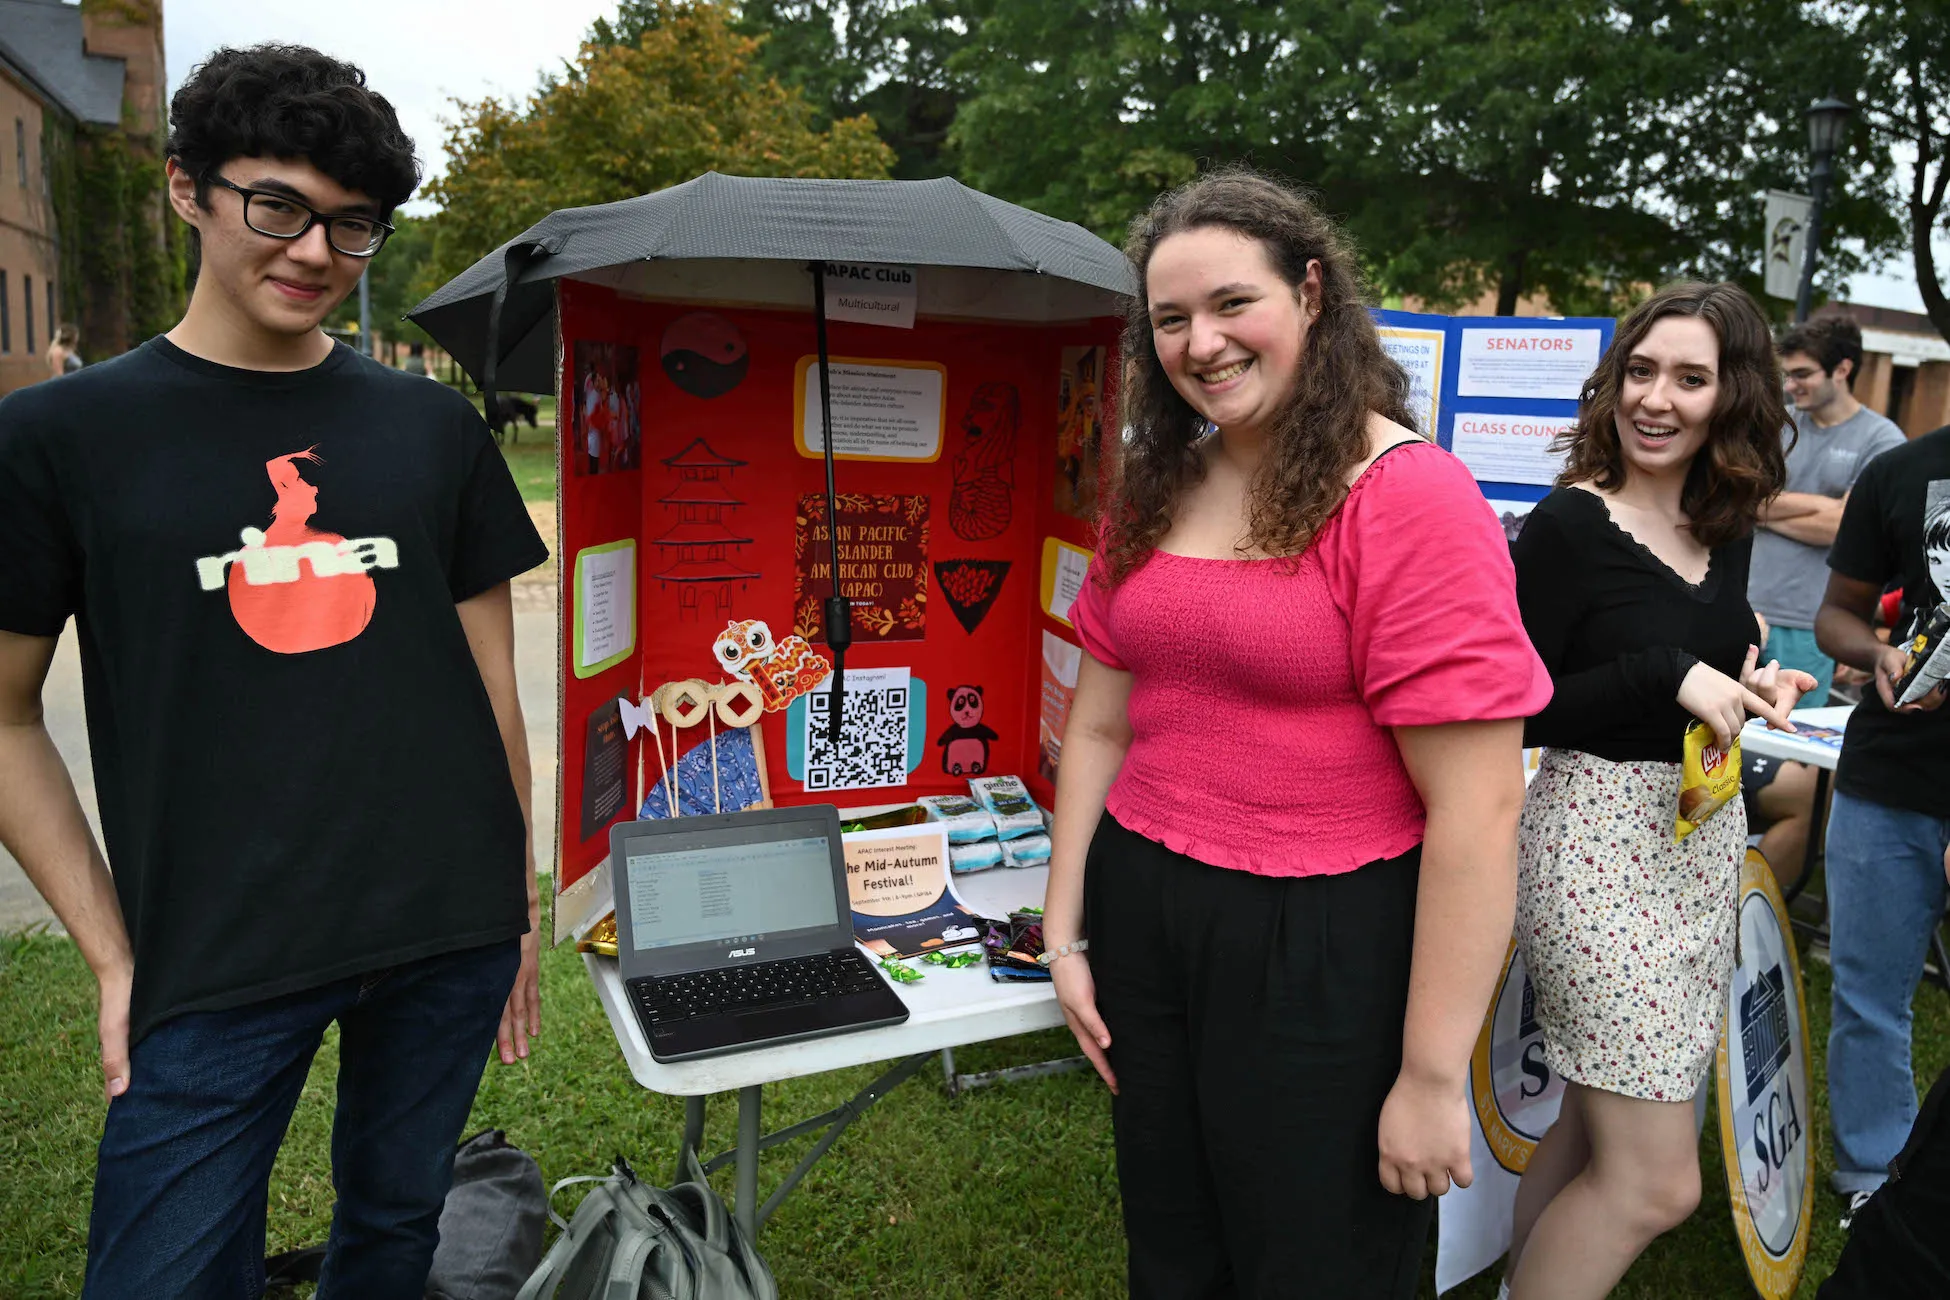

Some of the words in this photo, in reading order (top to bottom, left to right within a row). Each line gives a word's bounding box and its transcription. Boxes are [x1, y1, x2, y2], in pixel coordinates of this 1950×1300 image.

[827, 263, 871, 280] APAC
[876, 269, 912, 284] Club
[838, 298, 900, 312] Multicultural
[1382, 344, 1419, 354] EETINGS
[1487, 337, 1574, 351] SENATORS
[1462, 421, 1507, 435] CLASS
[837, 544, 893, 560] SLANDER
[810, 563, 877, 579] AMRICAN
[883, 563, 914, 579] CLUB
[840, 583, 884, 598] (APAC)
[984, 780, 1018, 791] gimme
[873, 846, 894, 854] Interest
[847, 862, 860, 874] he
[865, 856, 938, 872] Mid-Autumn
[864, 875, 913, 890] Festival!
[728, 947, 756, 959] ASUS
[1753, 1075, 1802, 1197] SGA
